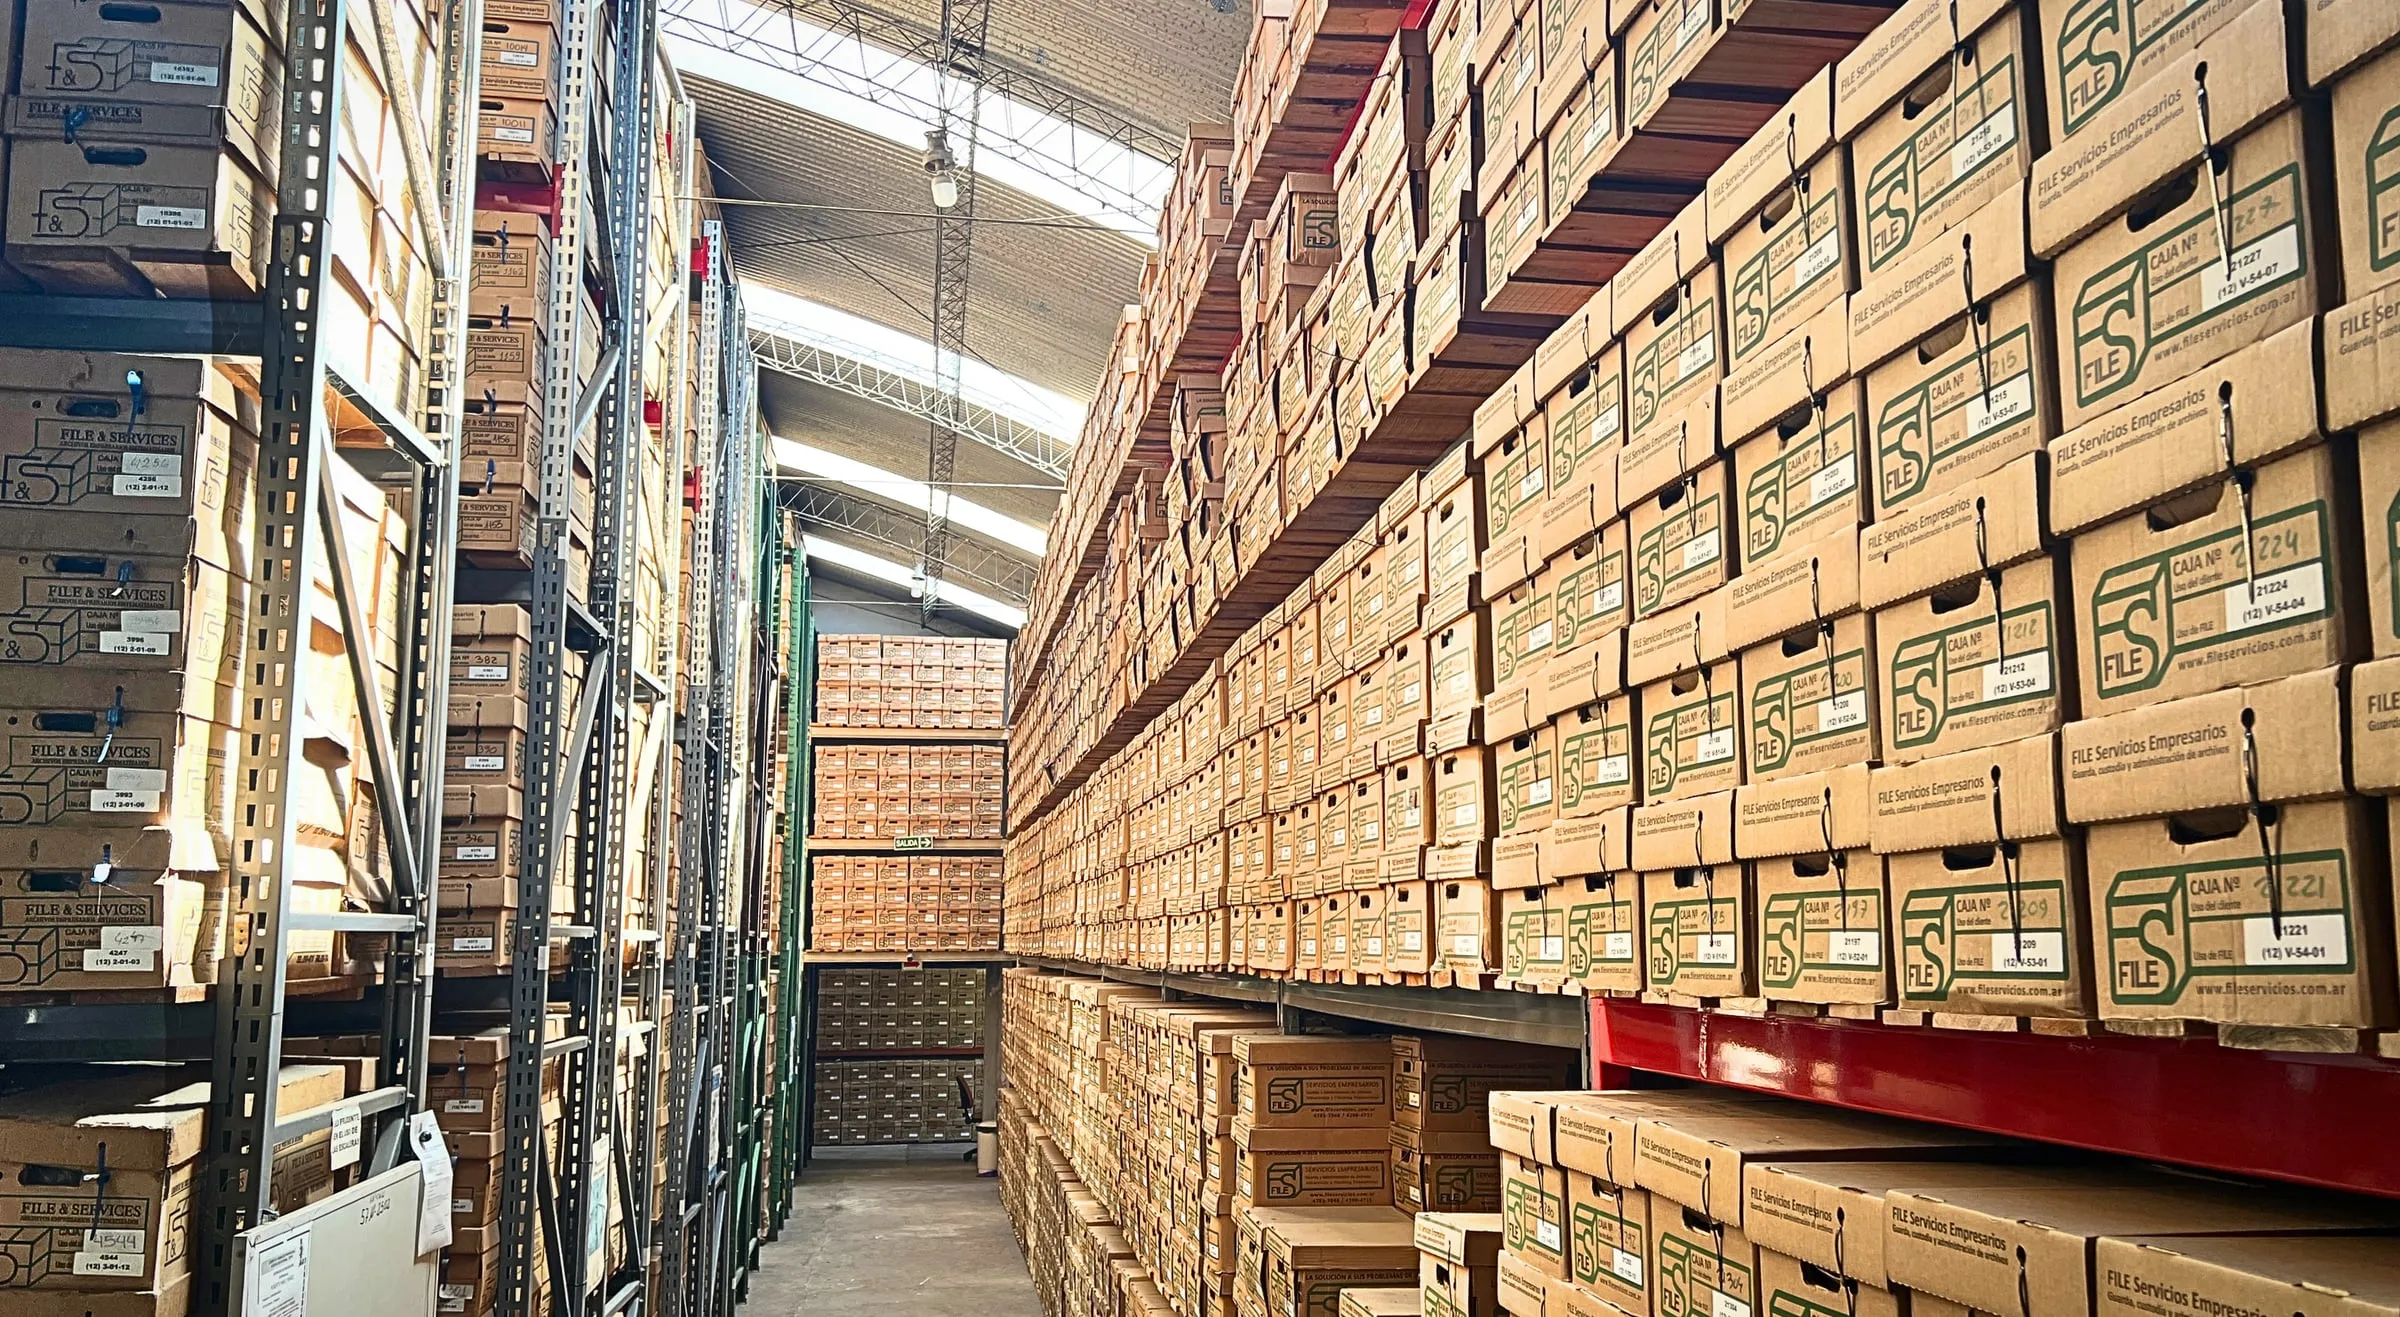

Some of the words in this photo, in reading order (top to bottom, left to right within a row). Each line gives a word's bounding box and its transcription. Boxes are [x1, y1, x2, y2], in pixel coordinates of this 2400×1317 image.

[512, 5, 544, 13] Empresarios
[1840, 73, 1855, 92] FILE
[1856, 45, 1889, 79] Servicios
[1890, 1, 1940, 49] Empresarios
[2070, 67, 2107, 115] FILE
[28, 103, 58, 113] FILE
[1918, 131, 1937, 152] CAJA
[2038, 172, 2059, 197] FILE
[2060, 141, 2108, 183] Servicios
[2110, 88, 2181, 149] Empresarios
[1713, 181, 1725, 199] FILE
[1725, 158, 1748, 190] Servicios
[1749, 127, 1785, 167] Empresarios
[1873, 219, 1900, 257] FILE
[2151, 248, 2179, 270] CAJA
[2231, 249, 2261, 272] 21227
[1854, 309, 1869, 327] FILE
[1870, 287, 1903, 317] Servicios
[1904, 253, 1954, 294] Empresarios
[2218, 284, 2237, 300] (12)
[2239, 263, 2278, 288] V-54-07
[1738, 317, 1756, 349] FILE
[2154, 290, 2296, 360] www.fileservicios.com.ar
[483, 335, 519, 343] SERVICES
[1727, 380, 1738, 396] FILE
[1739, 364, 1763, 390] Servicios
[1764, 339, 1801, 376] Empresarios
[2083, 350, 2121, 389] FILE
[1932, 379, 1952, 399] CAJA
[1978, 415, 1992, 429] (12)
[1993, 403, 2018, 421] V-53-07
[2057, 441, 2077, 464] FILE
[2079, 423, 2129, 455] Servicios
[2131, 387, 2206, 432] Empresarios
[60, 428, 94, 441] FILE
[97, 430, 107, 441] &
[109, 431, 177, 446] SERVICES
[1936, 426, 2031, 475] www.fileservicios.com.ar
[1886, 462, 1912, 494] FILE
[470, 503, 507, 512] SERVICES
[1868, 536, 1883, 550] FILE
[1884, 520, 1918, 544] Servicios
[1920, 498, 1971, 529] Empresarios
[1752, 524, 1772, 551] FILE
[2173, 558, 2203, 576] CAJA
[1733, 588, 1744, 600] FILE
[1745, 575, 1770, 595] Servicios
[1771, 561, 1808, 585] Empresarios
[2256, 580, 2288, 597] 21224
[48, 585, 81, 597] FILE
[85, 586, 94, 598] &
[97, 588, 166, 601] SERVICES
[2242, 609, 2262, 624] (12)
[2266, 598, 2305, 617] V-54-04
[1948, 636, 1970, 652] CAJA
[2177, 629, 2322, 671] www.fileservicios.com.ar
[474, 655, 497, 664] 382
[2004, 663, 2025, 675] 21212
[2104, 648, 2143, 681] FILE
[1993, 682, 2008, 695] (12)
[2009, 677, 2036, 692] V-53-04
[1899, 708, 1925, 735] FILE
[1949, 702, 2048, 731] www.fileservicios.com.ar
[31, 745, 65, 756] FILE
[68, 746, 78, 756] &
[1757, 739, 1778, 761] FILE
[2072, 746, 2093, 765] FILE
[2095, 739, 2146, 761] Servicios
[2149, 724, 2227, 752] Empresarios
[1878, 791, 1894, 805] FILE
[1895, 786, 1930, 802] Servicios
[1932, 776, 1984, 797] Empresarios
[1743, 803, 1755, 815] FILE
[1755, 798, 1782, 812] Servicios
[1782, 795, 1820, 810] Empresarios
[895, 838, 918, 848] SALIDA
[2190, 878, 2221, 895] CAJA
[25, 904, 59, 915] FILE
[64, 905, 72, 915] &
[76, 904, 146, 916] SERVICES
[1956, 899, 1977, 913] CAJA
[2278, 925, 2308, 937] 1221
[2003, 958, 2017, 968] (12)
[2262, 947, 2282, 960] (12)
[2285, 946, 2325, 958] V-54-01
[1767, 956, 1787, 976] FILE
[1908, 964, 1933, 986] FILE
[2119, 961, 2159, 988] FILE
[1803, 973, 1876, 986] www.fileservicios.com.ar
[1956, 984, 2062, 997] www.fileservicios.com.ar
[2196, 981, 2346, 996] www.fileservicios.com.ar
[1272, 1101, 1290, 1109] FILE
[1641, 1136, 1651, 1149] FILE
[1652, 1140, 1671, 1157] Servicios
[1671, 1148, 1702, 1169] Empresarios
[1271, 1186, 1289, 1194] FILE
[21, 1202, 55, 1215] FILE
[59, 1203, 68, 1214] &
[1750, 1187, 1763, 1201] FILE
[1764, 1191, 1791, 1209] Servicios
[1792, 1200, 1833, 1223] Empresarios
[1892, 1206, 1909, 1224] FILE
[1910, 1210, 1947, 1234] Servicios
[1949, 1221, 2006, 1251] Empresarios
[2107, 1269, 2132, 1290] FILE
[2133, 1276, 2189, 1306] Servicios
[1664, 1288, 1680, 1312] FILE
